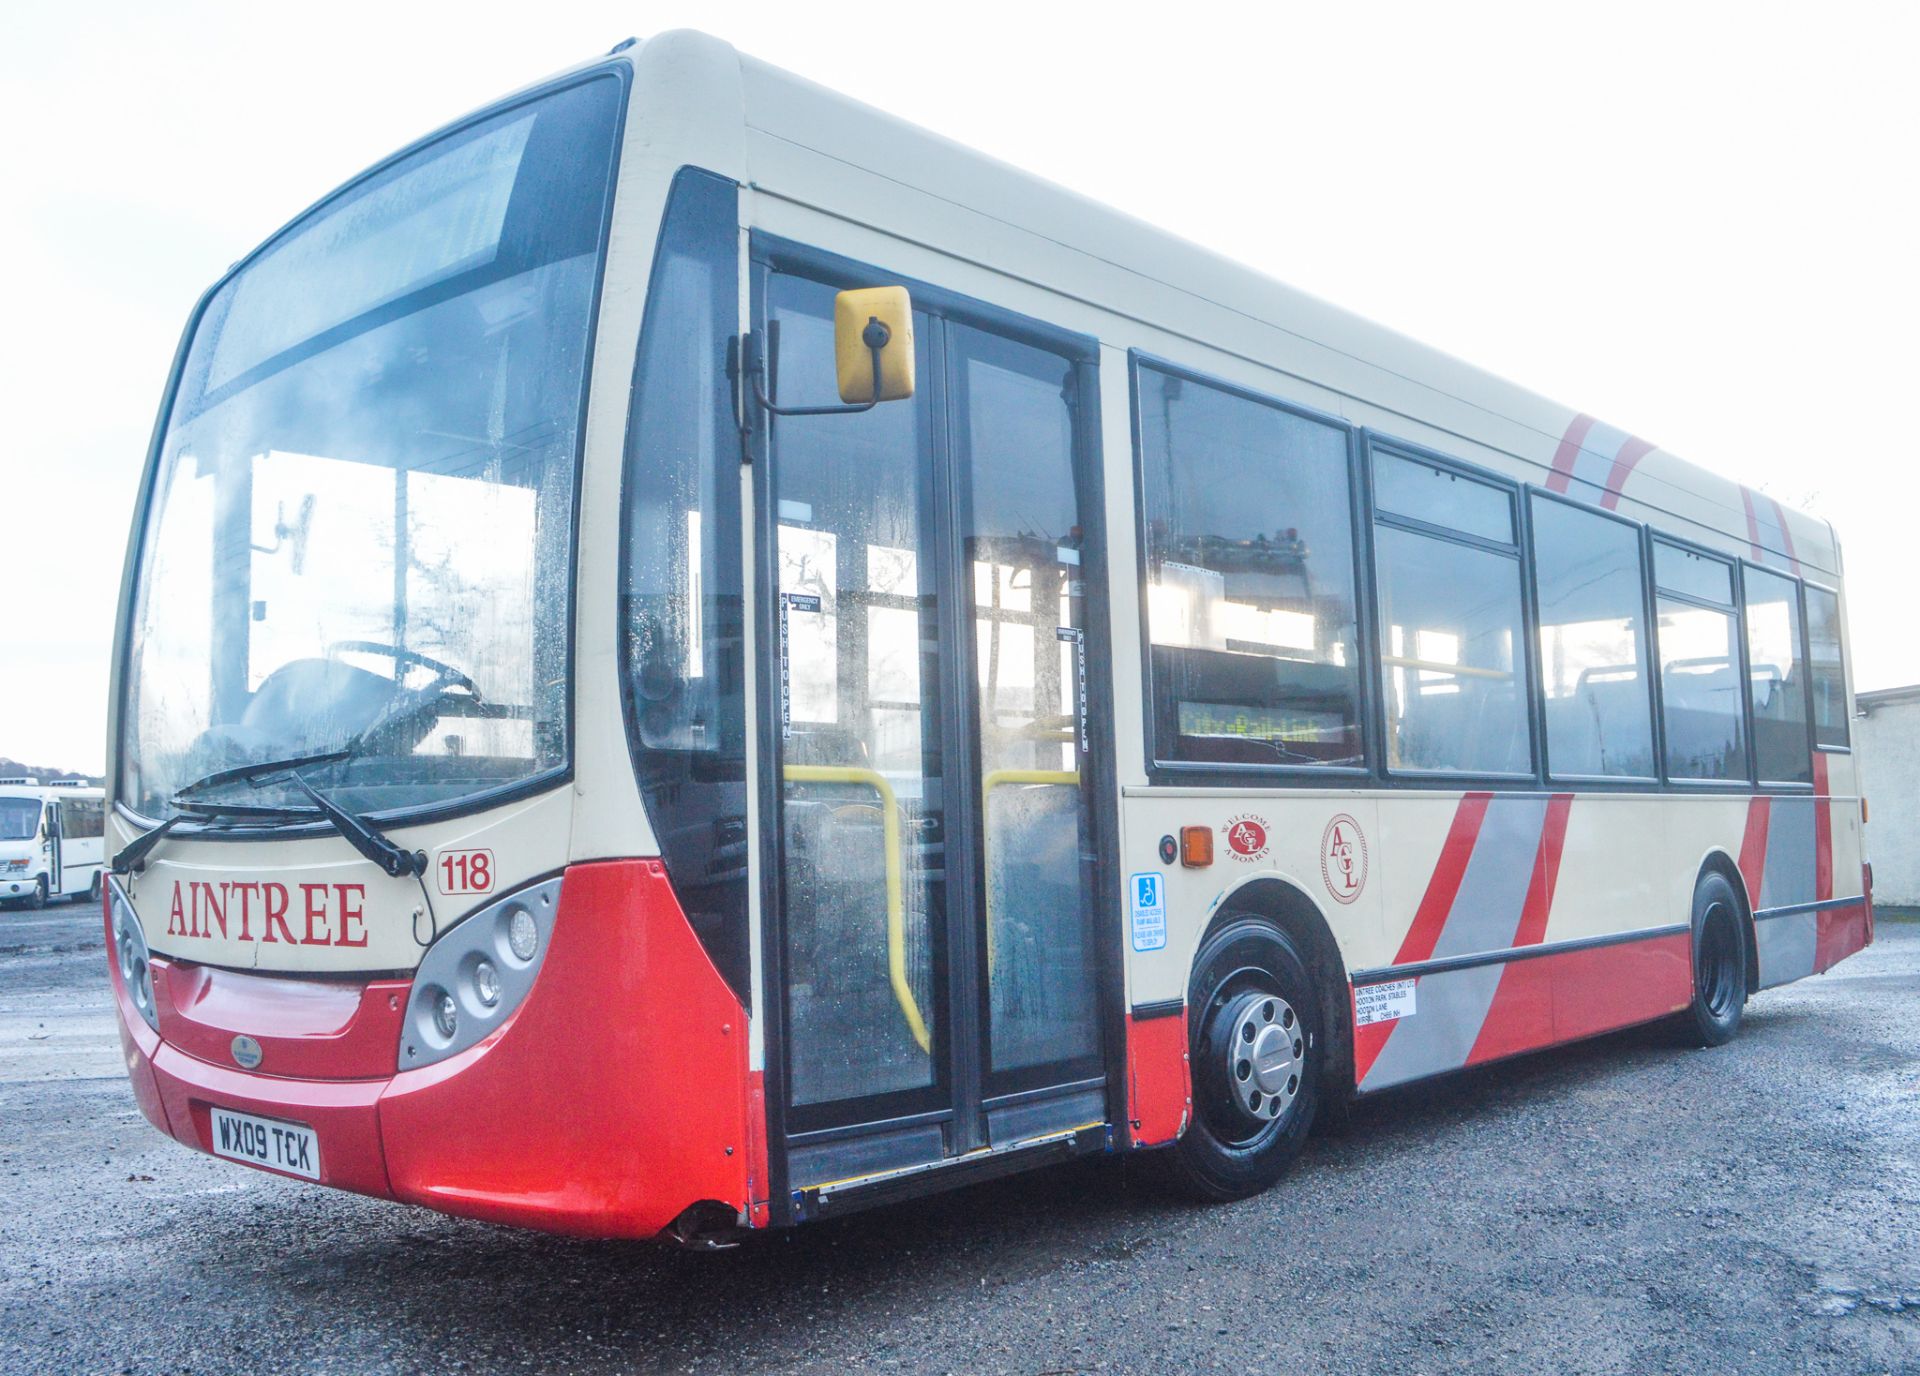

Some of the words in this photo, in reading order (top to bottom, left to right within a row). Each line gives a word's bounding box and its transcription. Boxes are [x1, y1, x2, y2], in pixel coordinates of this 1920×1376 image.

[790, 594, 818, 605] EMERGENCY
[799, 603, 812, 611] ONLY
[782, 656, 789, 680] TO
[1080, 682, 1086, 703] TO
[1221, 813, 1271, 834] WELCOME
[1224, 847, 1270, 863] ABOARD
[441, 852, 491, 891] 118
[167, 880, 368, 948] AINTREE
[219, 1115, 267, 1159] WX09
[272, 1127, 311, 1171] TCK
